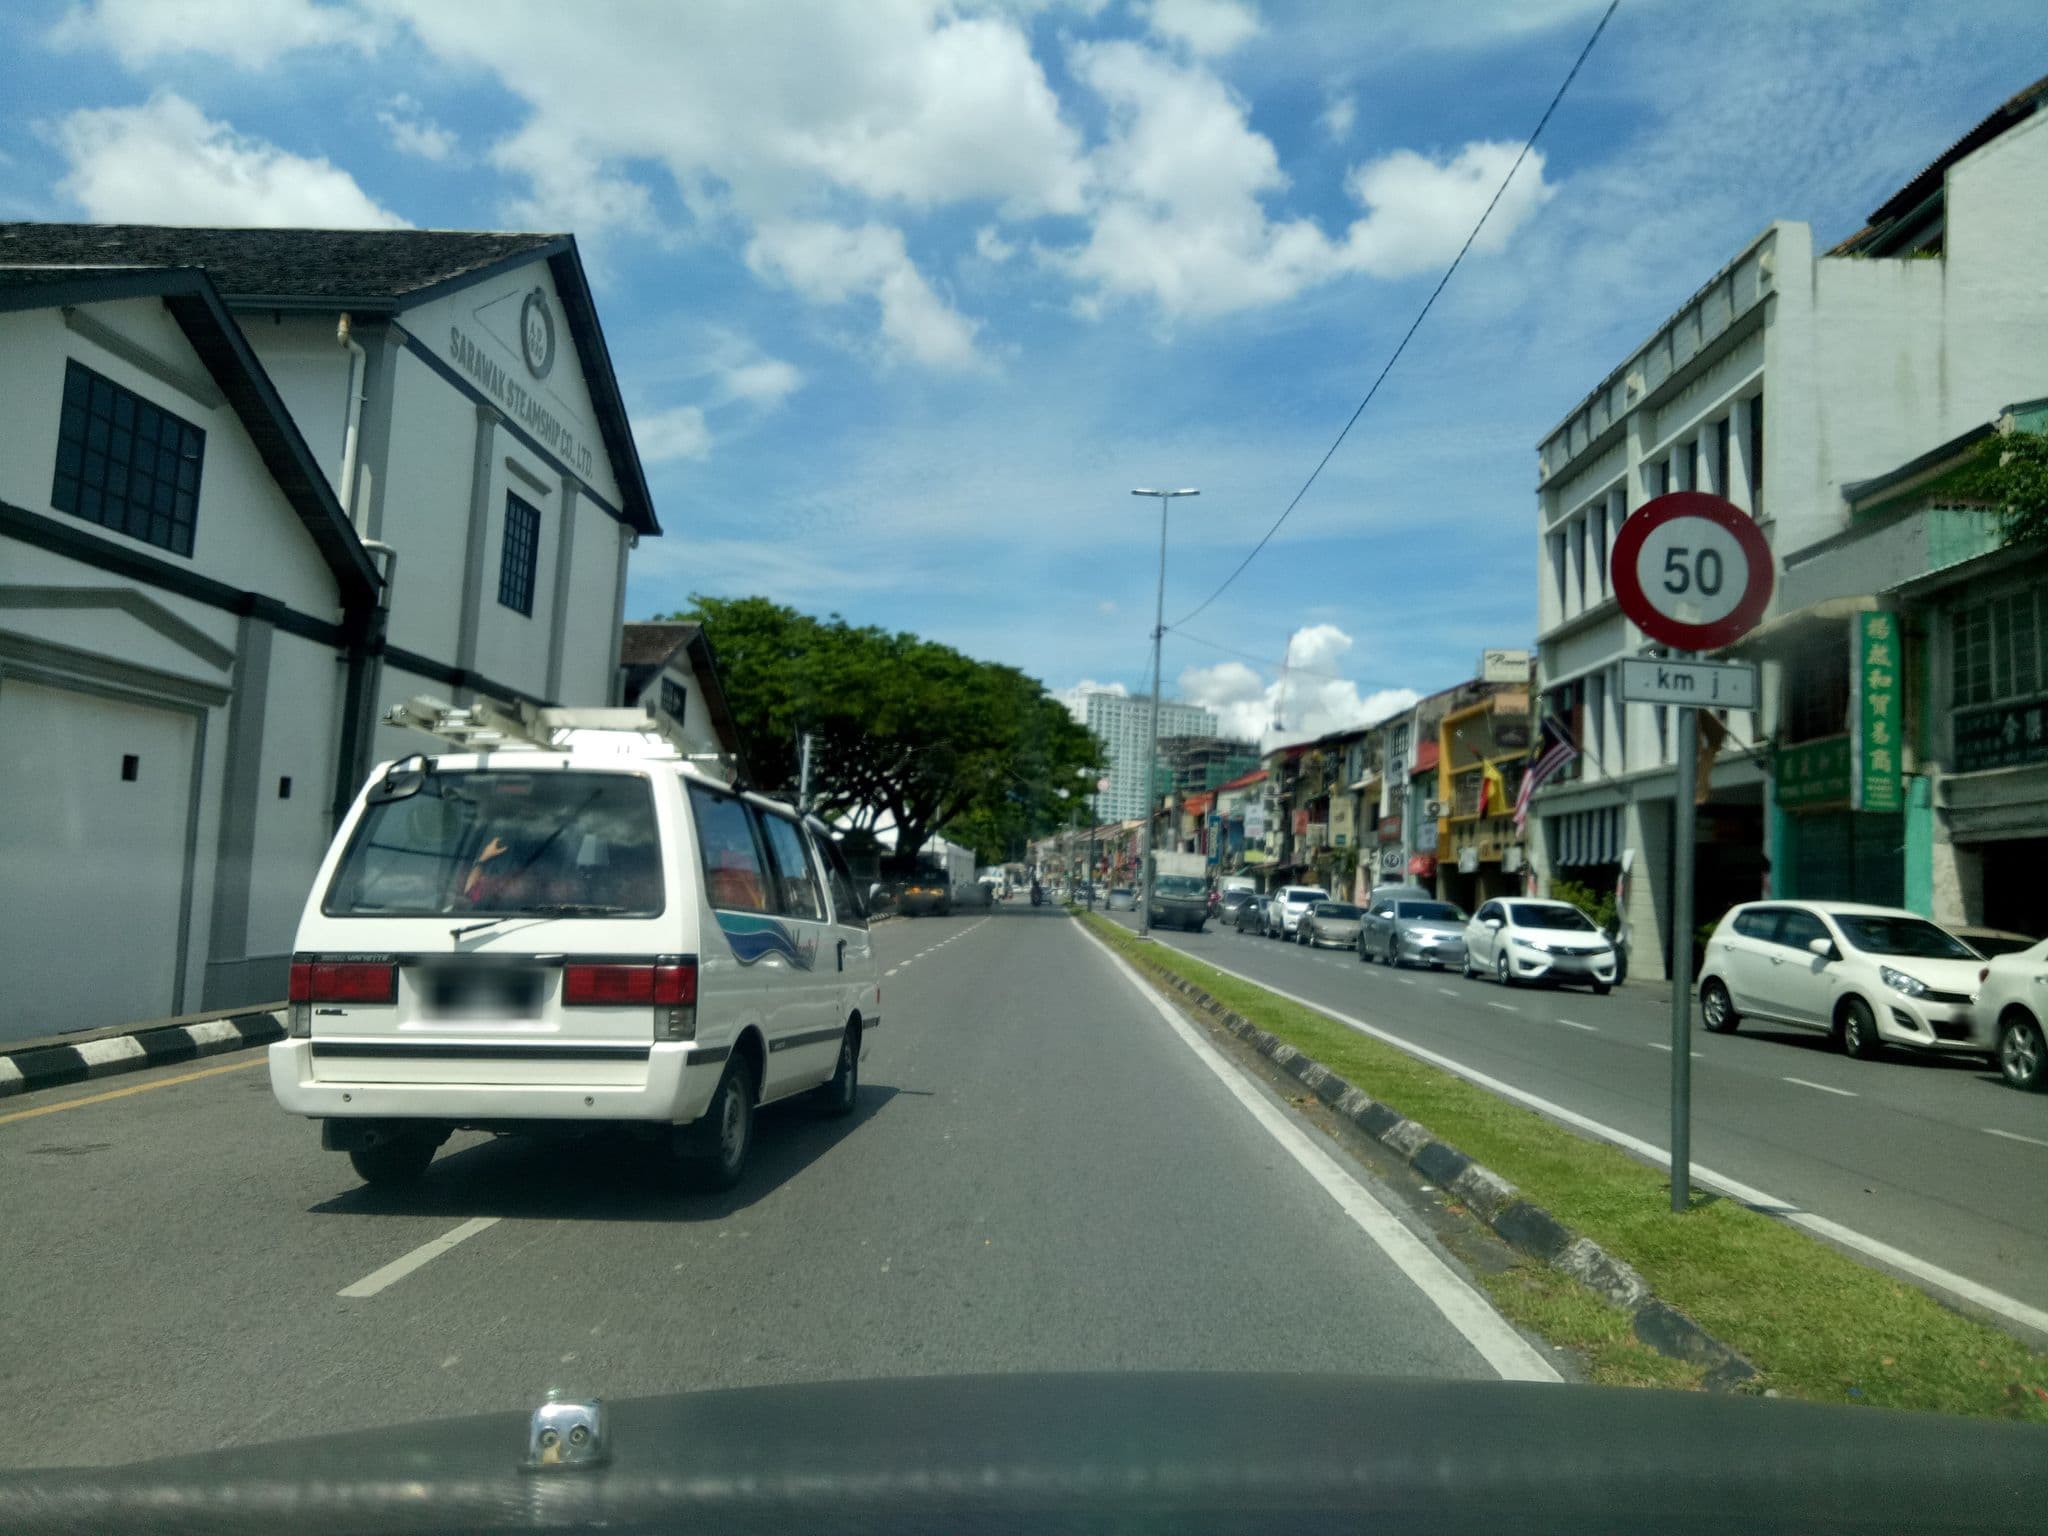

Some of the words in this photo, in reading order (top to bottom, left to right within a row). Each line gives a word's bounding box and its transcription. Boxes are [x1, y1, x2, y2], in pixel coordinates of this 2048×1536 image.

[450, 326, 506, 401] SARAWAK
[506, 378, 561, 446] STEAMSHIP
[1663, 547, 1723, 596] 50
[1657, 667, 1694, 692] km
